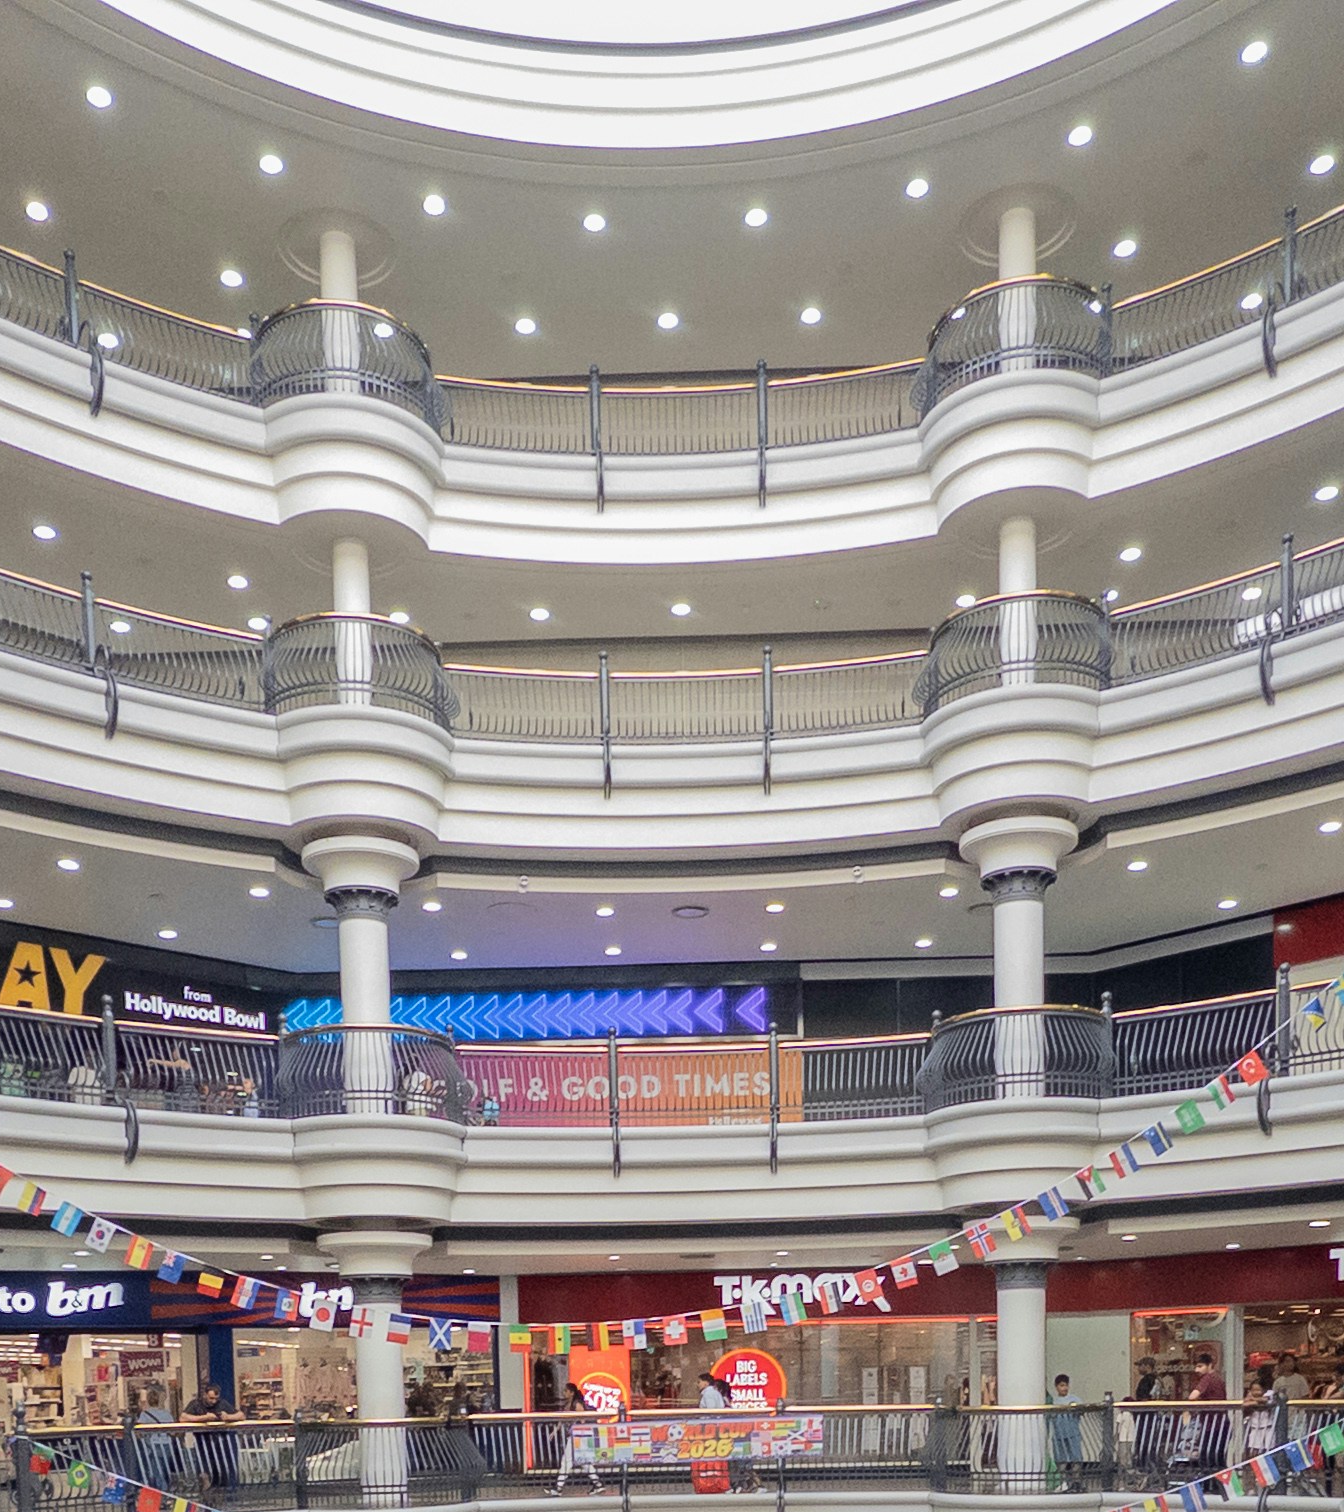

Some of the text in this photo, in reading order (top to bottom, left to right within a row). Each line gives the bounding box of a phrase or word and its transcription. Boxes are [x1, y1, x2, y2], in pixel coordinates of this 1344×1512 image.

[182, 985, 212, 1003] from
[124, 991, 266, 1031] Hollywood Bowl
[526, 1077, 549, 1102] &
[561, 1073, 662, 1100] GOOD
[673, 1071, 771, 1097] TIMES
[46, 1281, 124, 1317] b&m
[736, 1360, 757, 1373] BIG
[725, 1372, 768, 1386] LABELS
[730, 1388, 765, 1401] SMALL
[677, 1439, 733, 1459] 2026
